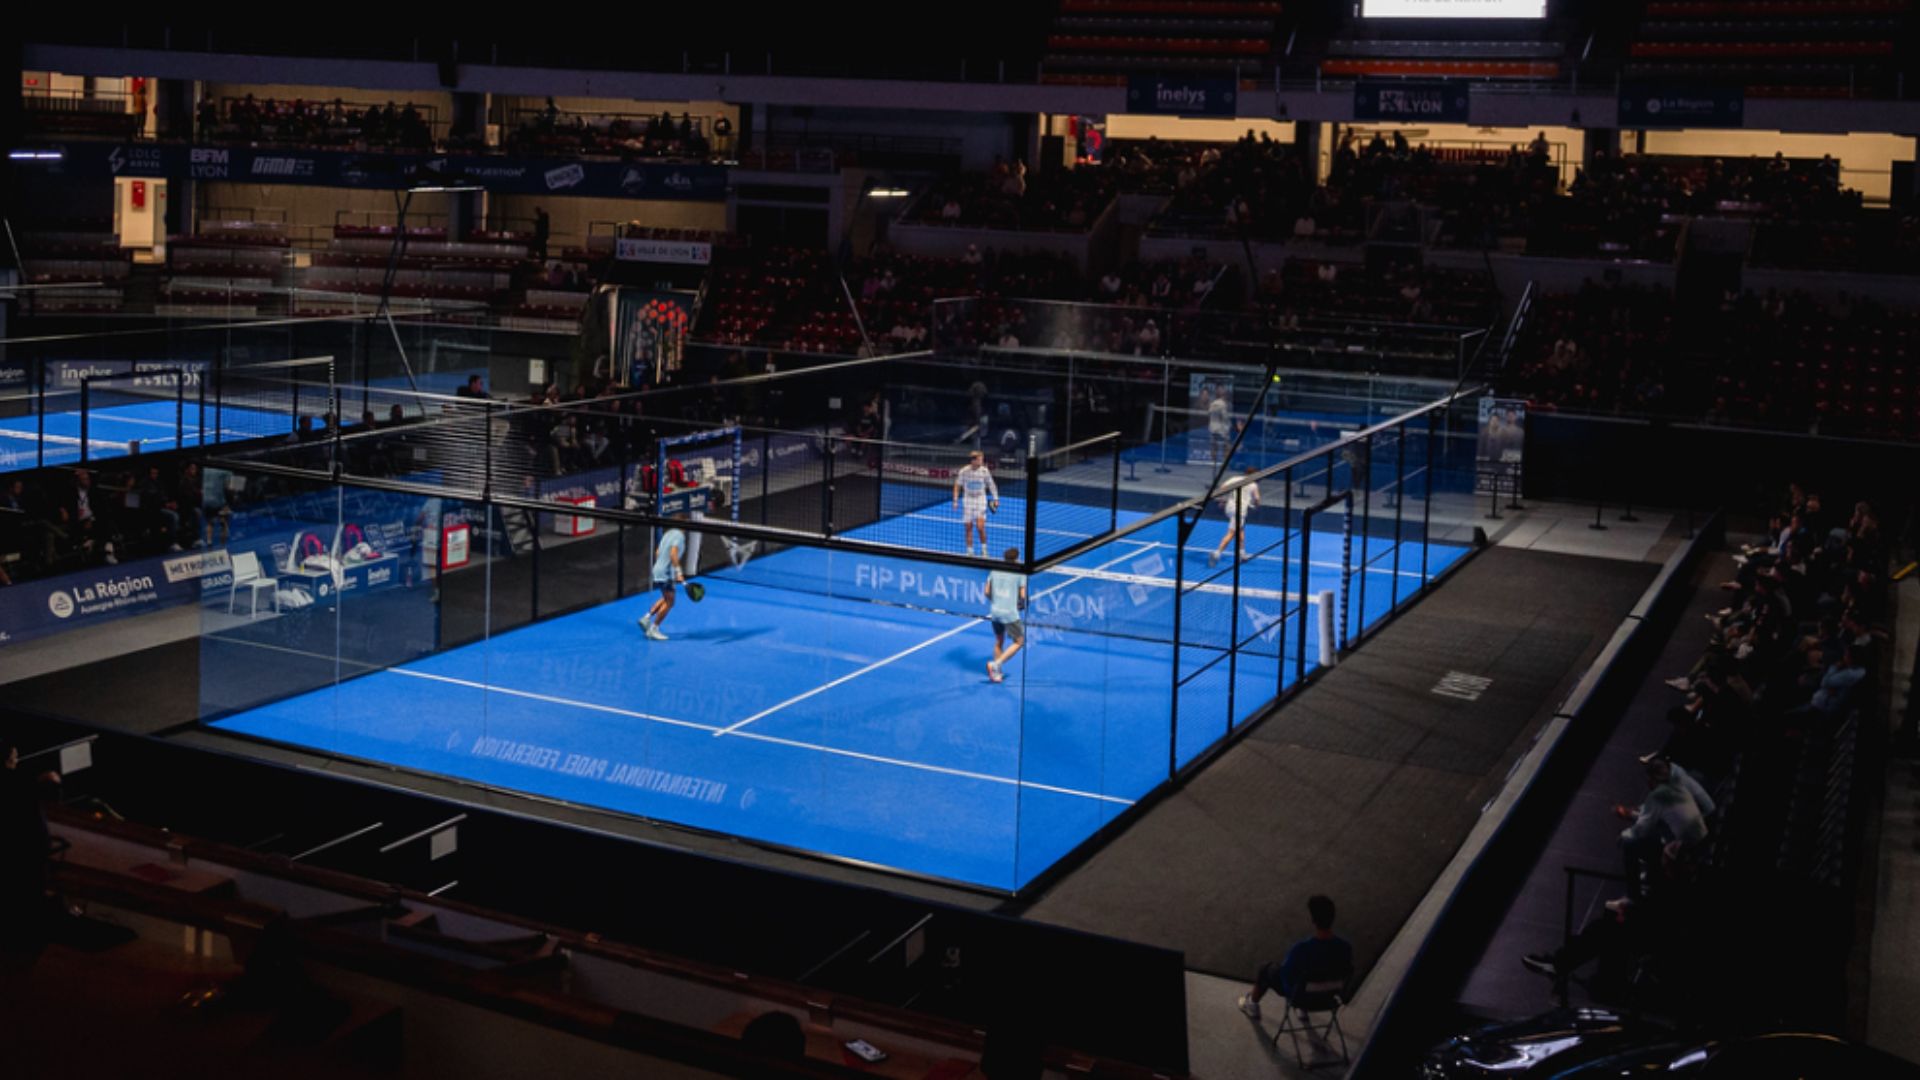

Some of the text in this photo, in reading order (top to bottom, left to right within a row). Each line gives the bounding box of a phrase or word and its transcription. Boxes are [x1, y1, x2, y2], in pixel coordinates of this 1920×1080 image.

[1157, 83, 1205, 104] inelys
[1404, 99, 1442, 112] LYON
[190, 148, 229, 163] BFM
[191, 164, 228, 177] LYON
[73, 575, 154, 603] La Région
[855, 563, 1105, 620] FIP PLATIN LYON
